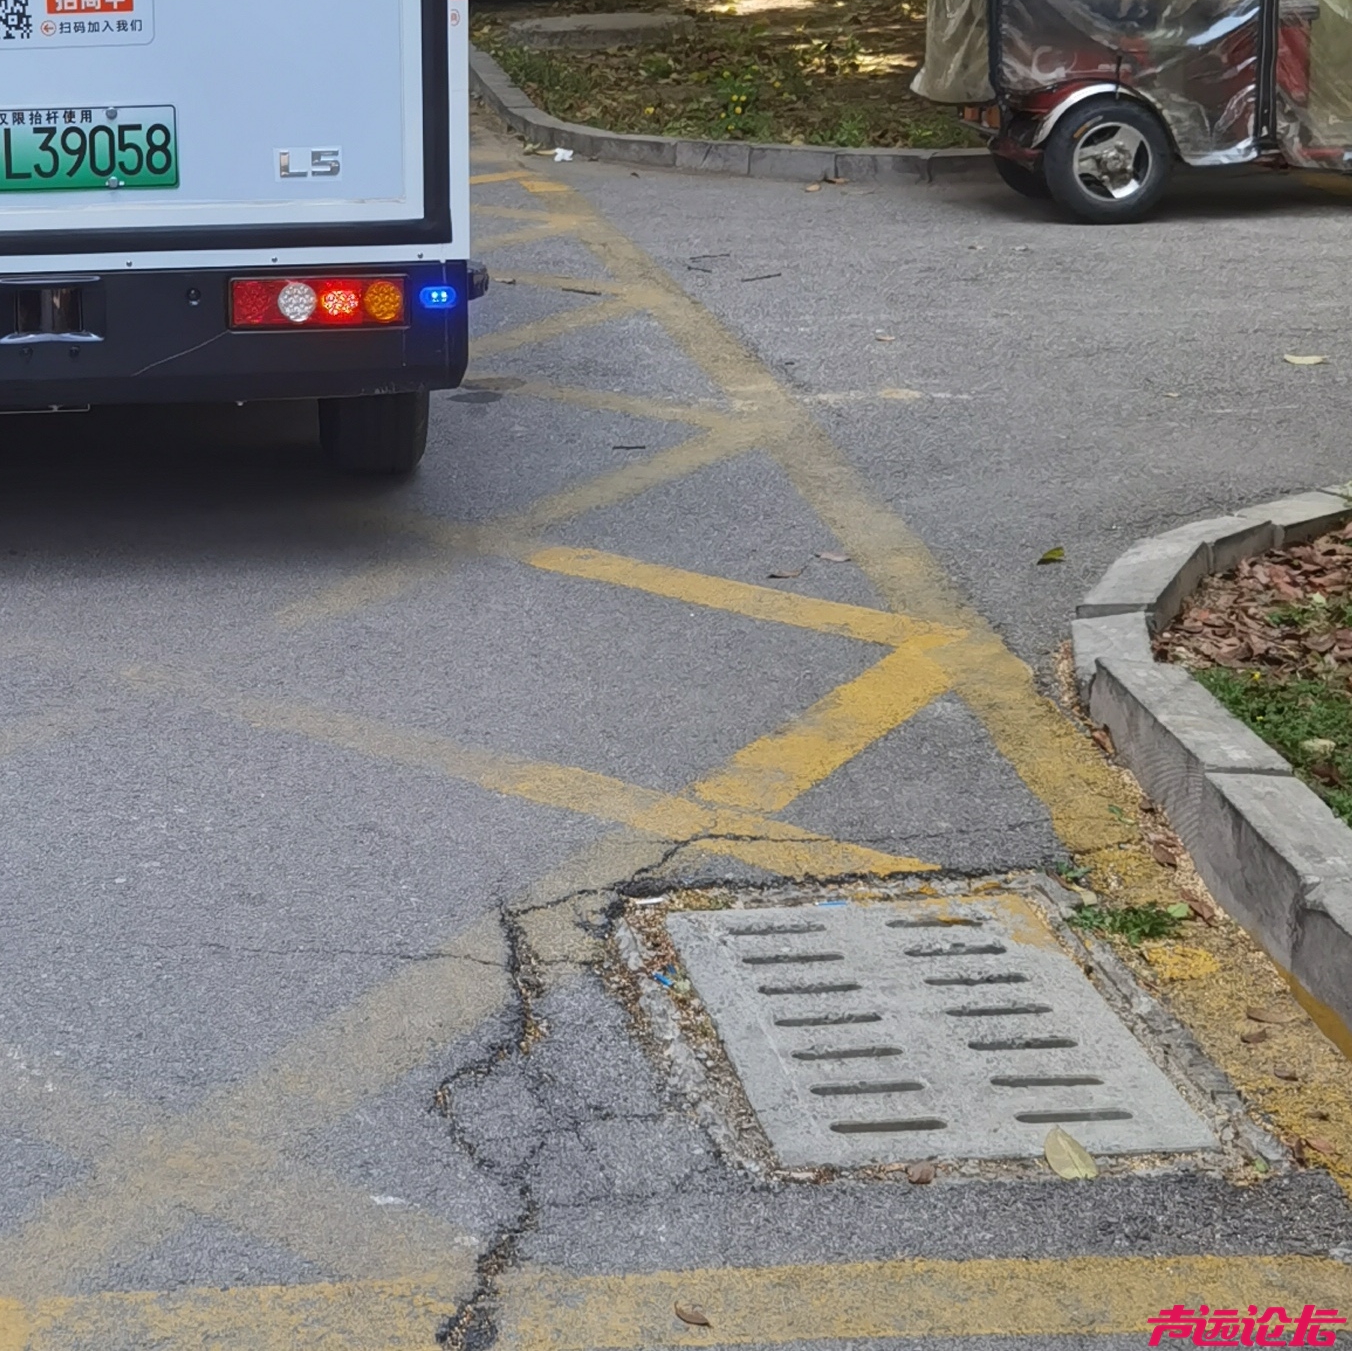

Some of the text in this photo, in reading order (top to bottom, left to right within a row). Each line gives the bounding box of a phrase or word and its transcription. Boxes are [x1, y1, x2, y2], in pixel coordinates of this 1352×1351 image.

[59, 19, 143, 34] 扫码加入我们
[279, 150, 341, 178] L5
